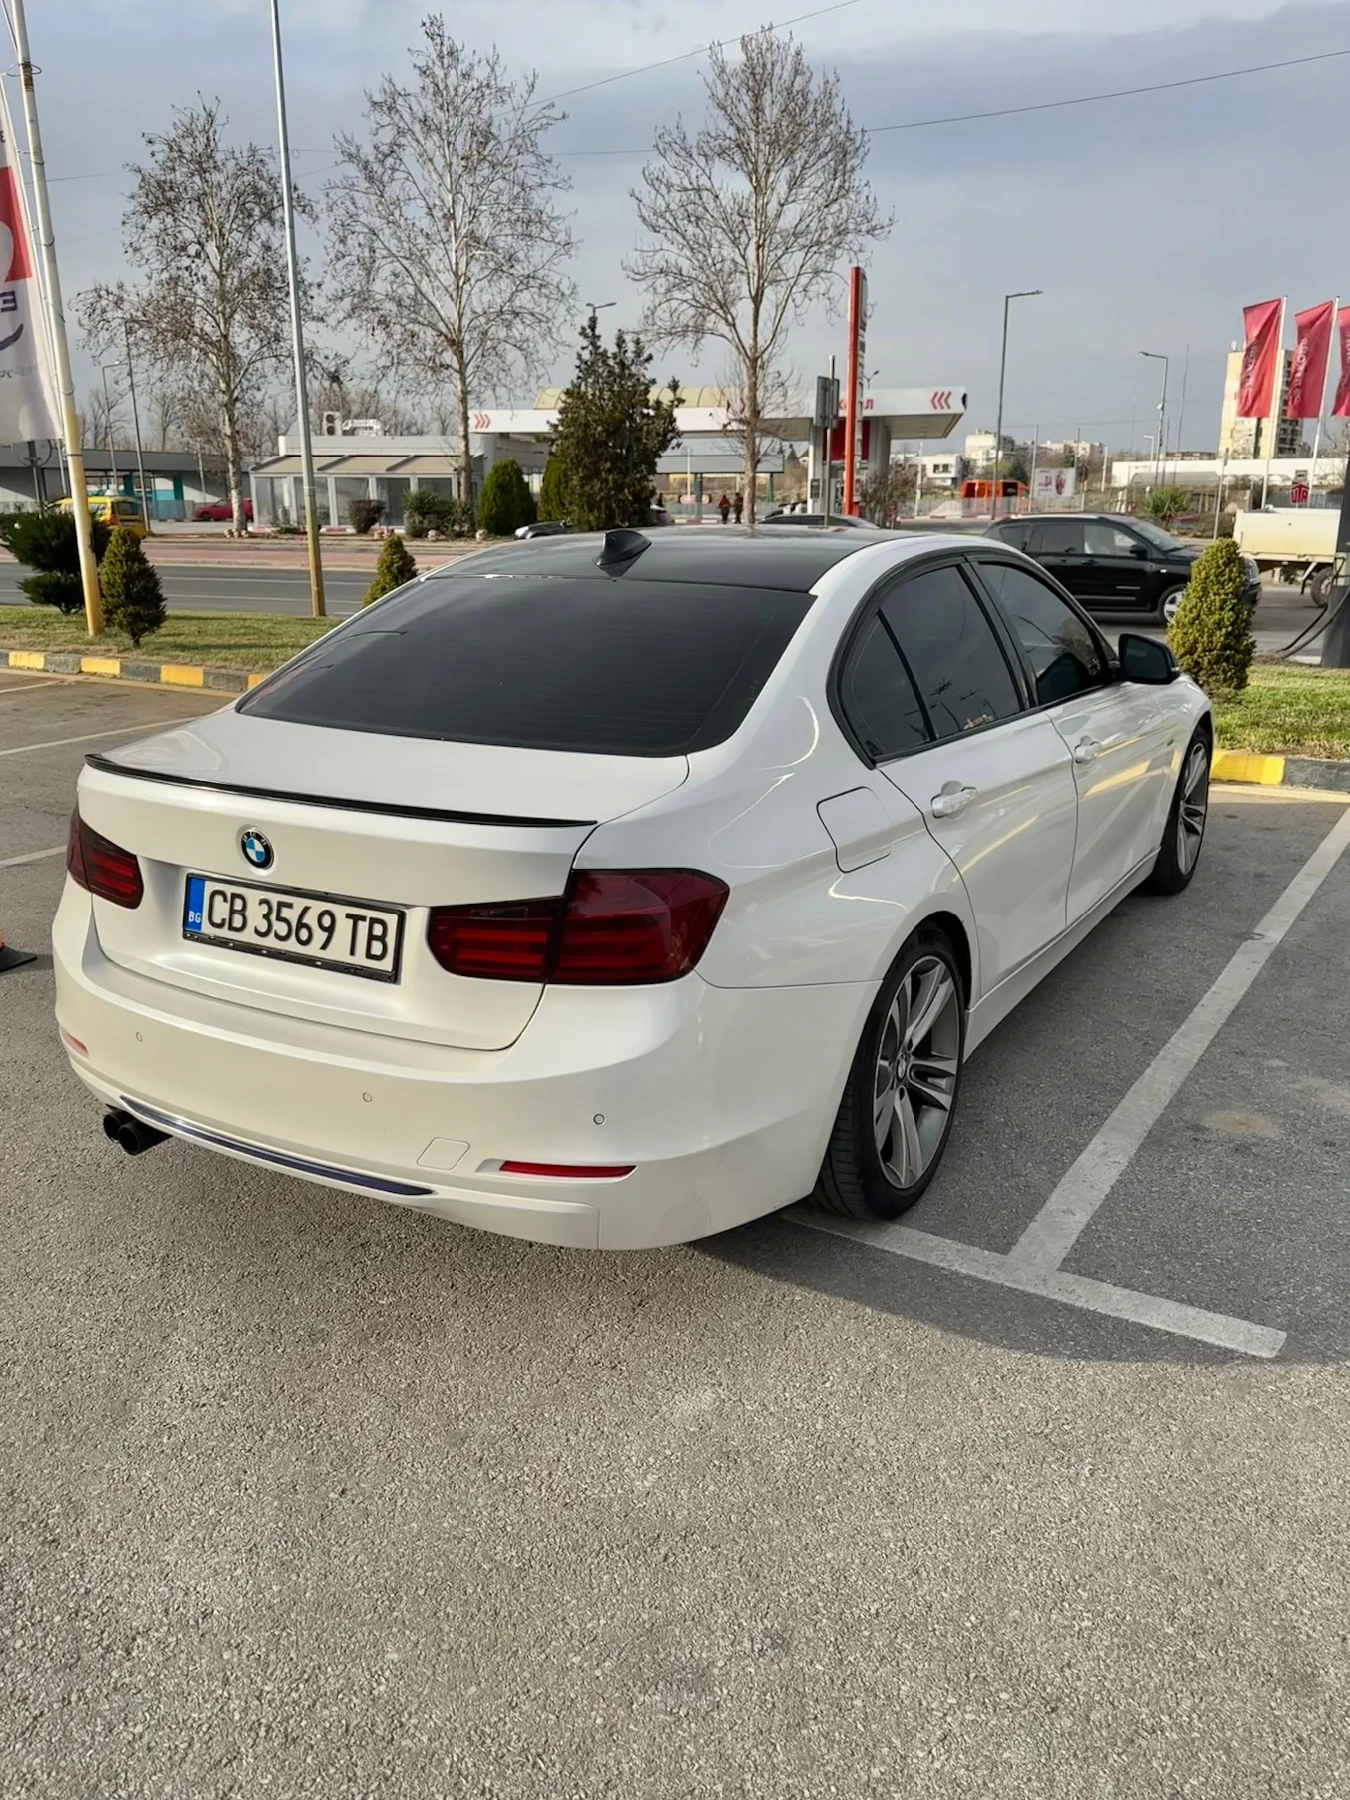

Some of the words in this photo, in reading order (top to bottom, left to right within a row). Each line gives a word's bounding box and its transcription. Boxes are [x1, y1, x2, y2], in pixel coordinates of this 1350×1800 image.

[188, 911, 201, 923] BG
[208, 889, 247, 932] CB
[254, 898, 336, 950] 3569
[345, 913, 388, 961] TB
